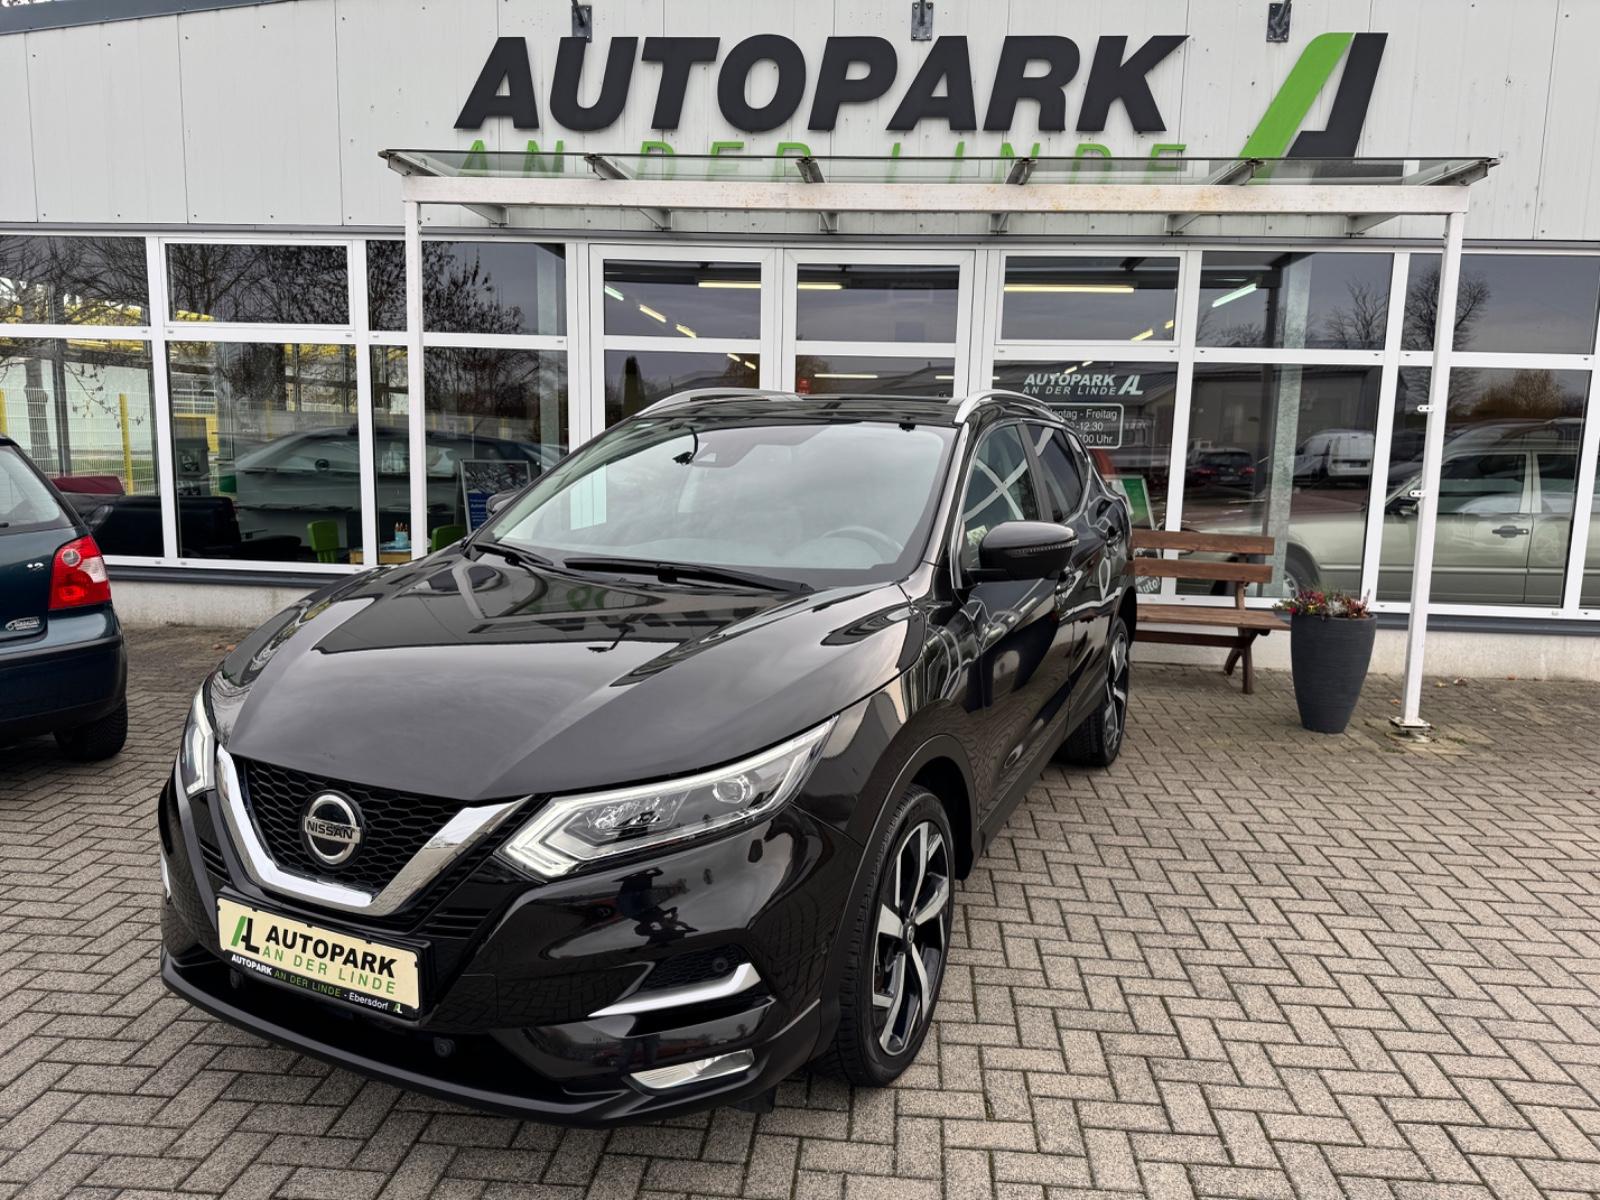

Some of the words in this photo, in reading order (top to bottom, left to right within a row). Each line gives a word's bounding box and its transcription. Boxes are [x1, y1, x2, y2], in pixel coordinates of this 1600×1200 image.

[453, 33, 1190, 132] AUTOPARK
[457, 138, 565, 180] AN
[634, 140, 818, 181] DER
[885, 141, 1187, 184] LINDE
[1023, 387, 1040, 395] AN
[1045, 386, 1071, 396] DER
[1077, 386, 1117, 396] LINDE
[1024, 373, 1116, 386] AUTOPARK
[1086, 408, 1118, 422] Freitag
[1096, 433, 1113, 444] Uhr
[306, 820, 355, 840] NISSAN
[265, 925, 398, 979] AUTOPARK
[231, 953, 273, 977] AUTOPARK
[274, 969, 287, 982] AN
[290, 975, 309, 988] DER
[312, 980, 342, 998] LINDE
[349, 991, 390, 1011] Ebersdorf
[262, 945, 284, 962] AN
[293, 955, 328, 976] DER
[338, 968, 397, 995] LINDE
